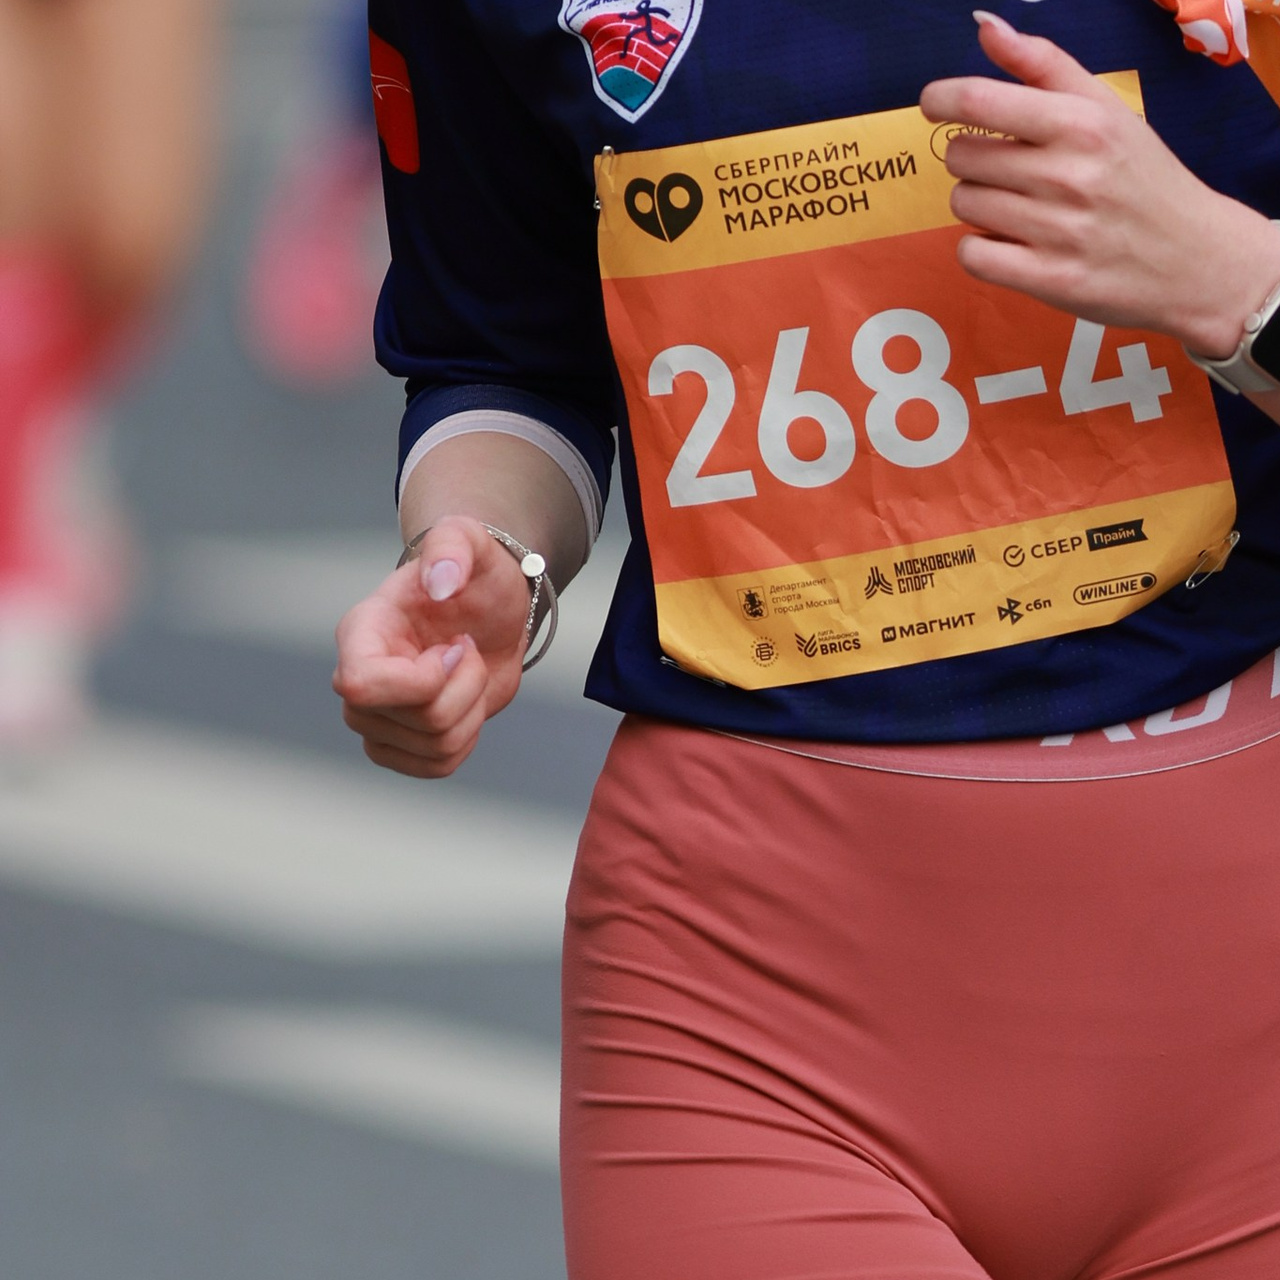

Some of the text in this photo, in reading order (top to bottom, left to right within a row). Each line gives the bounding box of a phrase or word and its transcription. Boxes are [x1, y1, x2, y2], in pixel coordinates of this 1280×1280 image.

[714, 141, 861, 181] СБЕРПРАЙМ
[718, 150, 918, 209] МОСКОВСКИЙ
[723, 189, 870, 235] МАРАФОН
[1030, 528, 1136, 559] СБЕР Прайм
[893, 544, 977, 578] МОСКОВСКИЙ
[769, 577, 827, 595] Департамент
[897, 572, 935, 595] СПОРТ
[1080, 579, 1139, 601] WINLINE
[771, 593, 802, 604] спорта
[773, 597, 840, 617] города Москвы
[819, 638, 861, 656] BRICS
